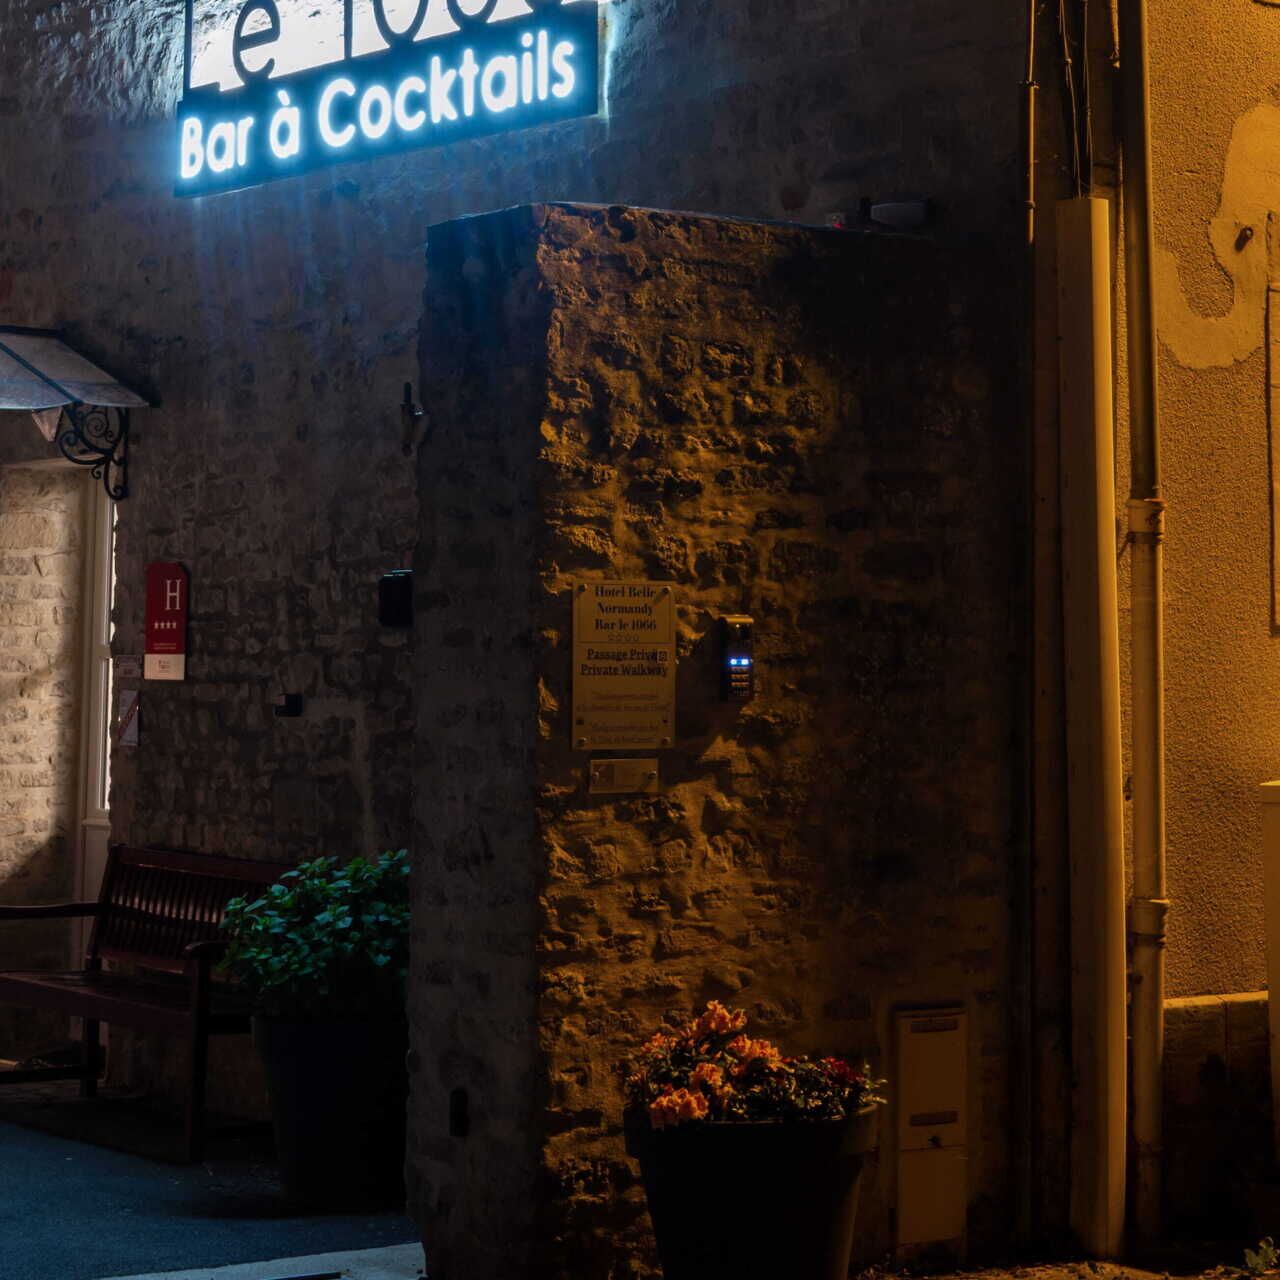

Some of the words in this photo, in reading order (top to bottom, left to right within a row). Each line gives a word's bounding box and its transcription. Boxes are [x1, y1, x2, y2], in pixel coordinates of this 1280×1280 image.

[180, 114, 254, 179] Bar
[268, 88, 301, 159] à
[319, 29, 576, 148] Cocktails
[165, 578, 182, 611] H
[596, 602, 655, 617] Normandy
[595, 619, 616, 630] Bar
[632, 619, 657, 630] 1066
[586, 648, 628, 662] Passage
[580, 663, 619, 676] Private
[620, 663, 669, 678] Walkway
